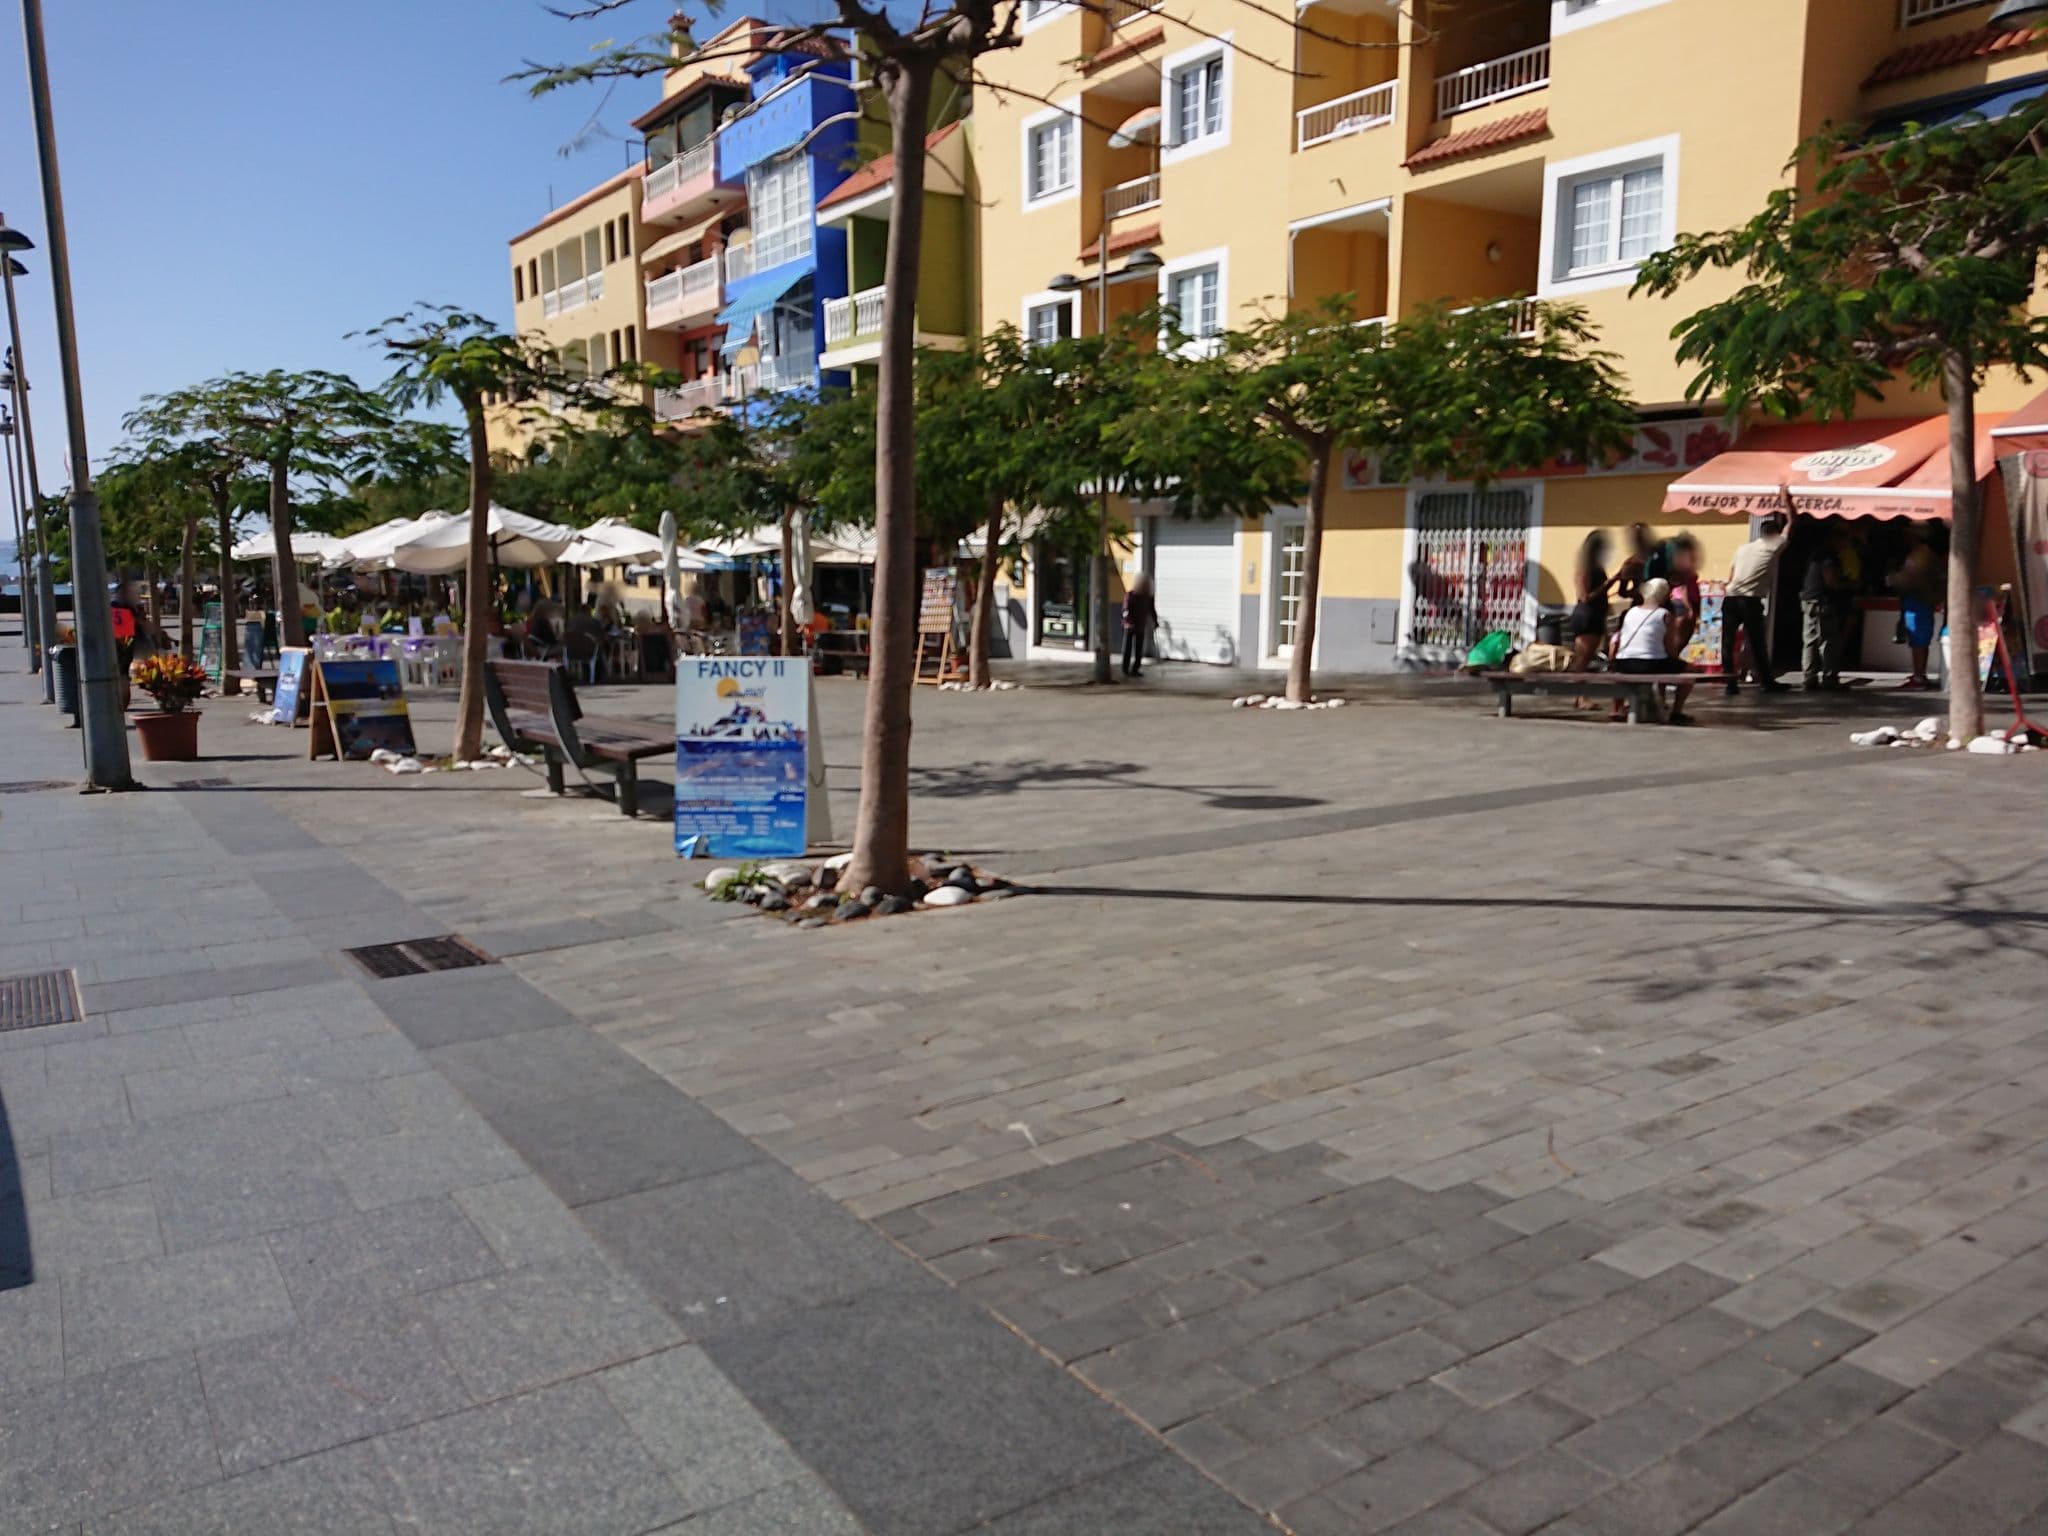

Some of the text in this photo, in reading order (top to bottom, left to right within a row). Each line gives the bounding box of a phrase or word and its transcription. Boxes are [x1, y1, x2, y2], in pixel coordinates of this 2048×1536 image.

[1687, 495, 1739, 508] MEJOR
[1745, 497, 1754, 508] Y
[698, 660, 785, 678] FANCY II
